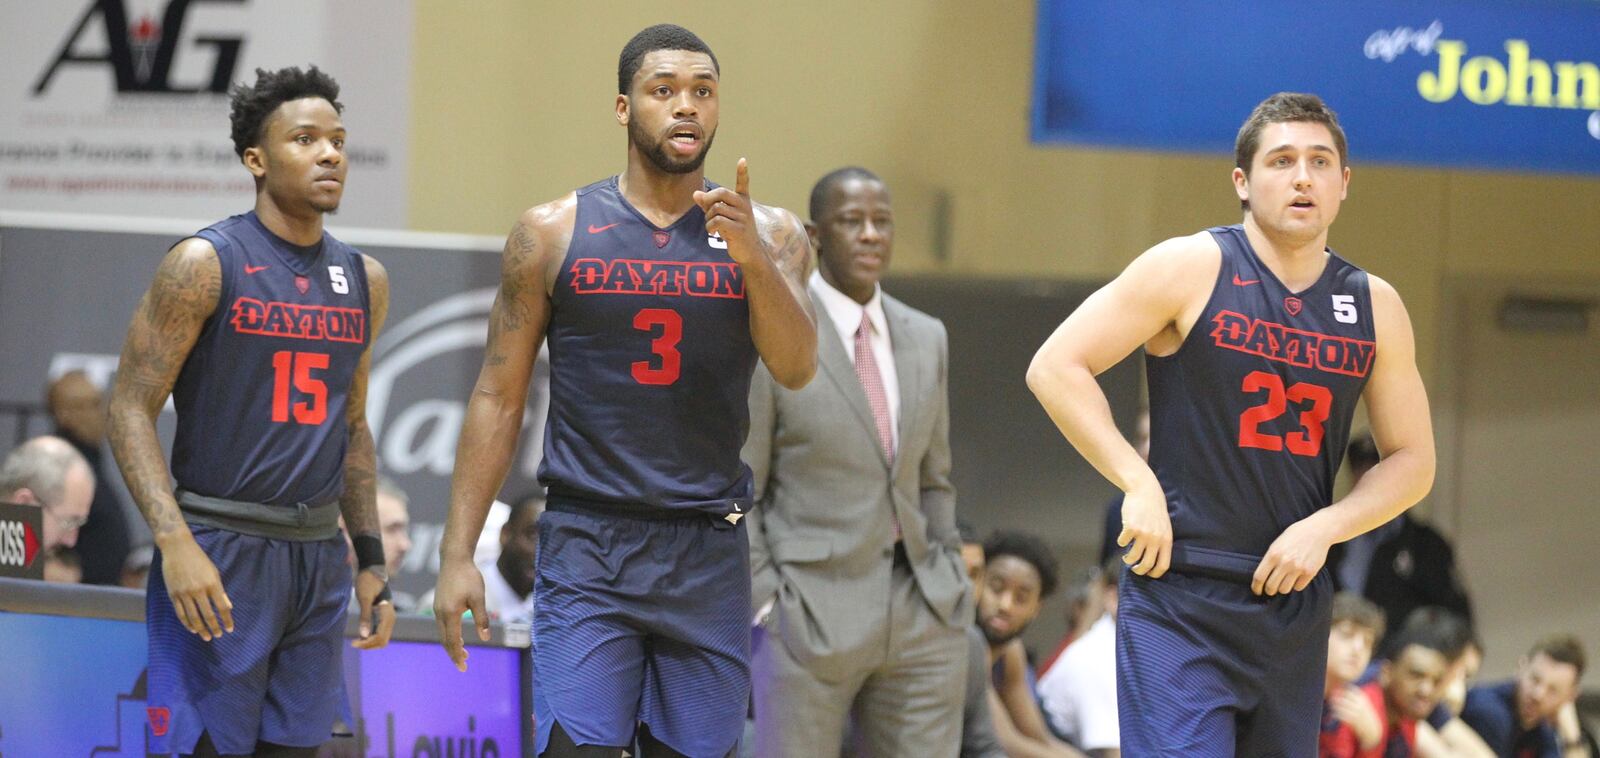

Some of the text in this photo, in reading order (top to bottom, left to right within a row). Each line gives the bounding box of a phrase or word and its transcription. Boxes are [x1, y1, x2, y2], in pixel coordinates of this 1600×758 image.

[328, 266, 349, 295] 5
[569, 258, 744, 299] DAYTON
[230, 297, 364, 343] DAYTON
[1331, 294, 1357, 324] 5
[631, 308, 683, 385] 3
[1210, 309, 1376, 378] DAYTON
[271, 350, 330, 425] 15
[1238, 370, 1333, 457] 23
